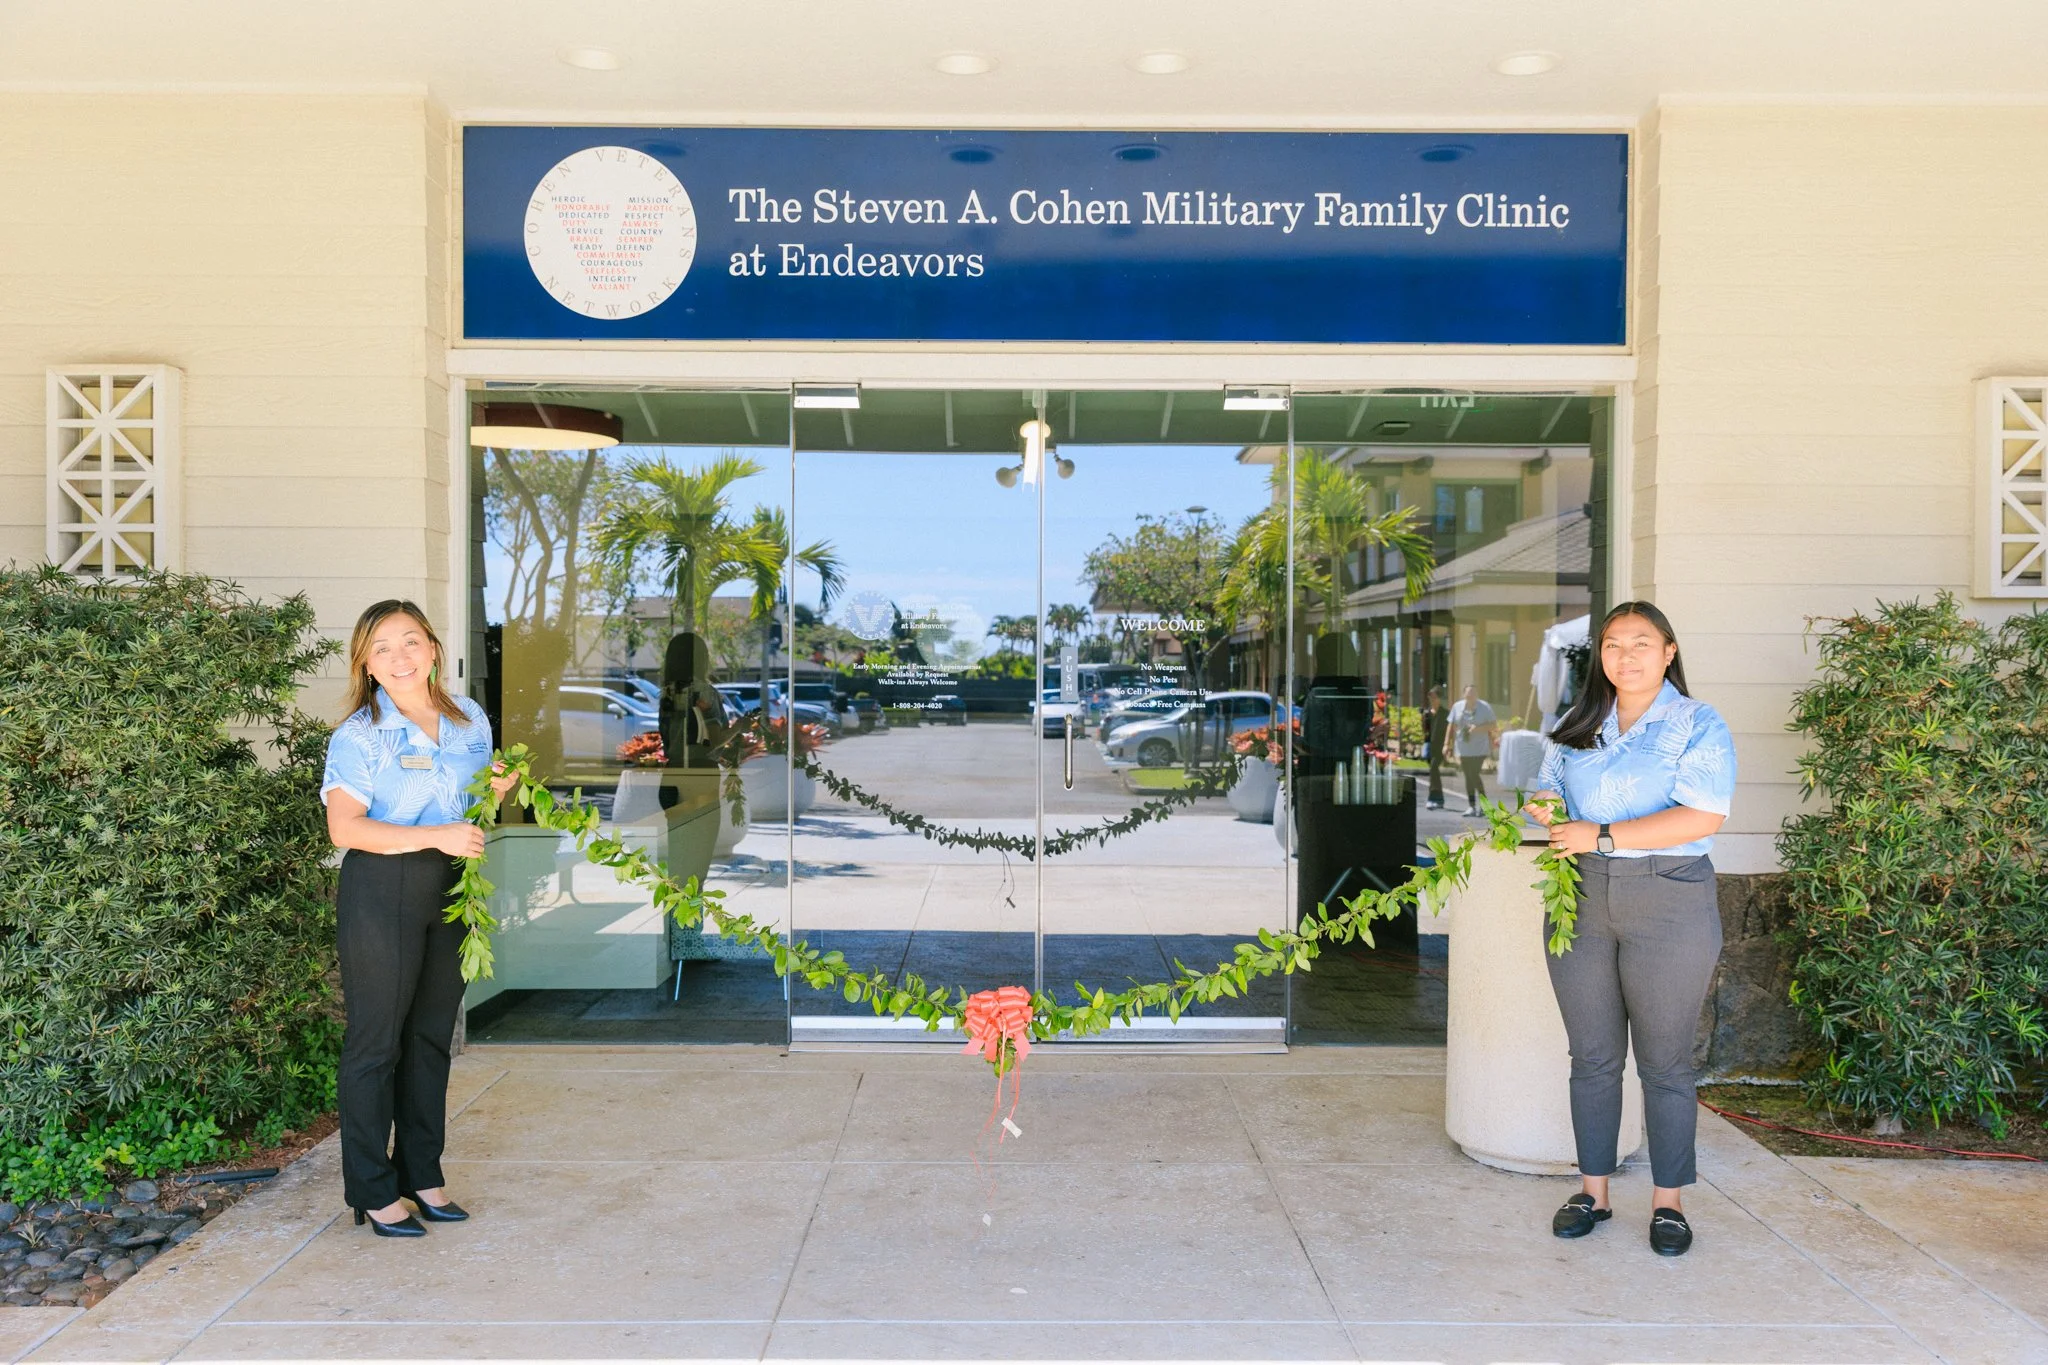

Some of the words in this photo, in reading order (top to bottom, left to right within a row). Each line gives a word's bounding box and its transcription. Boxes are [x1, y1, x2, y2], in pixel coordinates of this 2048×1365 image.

[528, 162, 572, 257] COHEN
[595, 149, 694, 260] VETERANS
[729, 188, 802, 223] The
[814, 189, 948, 223] Steven
[958, 190, 997, 224] A.
[1010, 188, 1131, 224] Cohen
[1142, 191, 1305, 233] Military
[1315, 192, 1447, 234] Family
[1457, 193, 1569, 228] Clinic
[730, 244, 766, 276] at
[779, 243, 983, 276] Endeavors
[544, 276, 677, 317] NETWORK
[1121, 620, 1205, 631] WELCOME
[1154, 664, 1186, 672] Weapons
